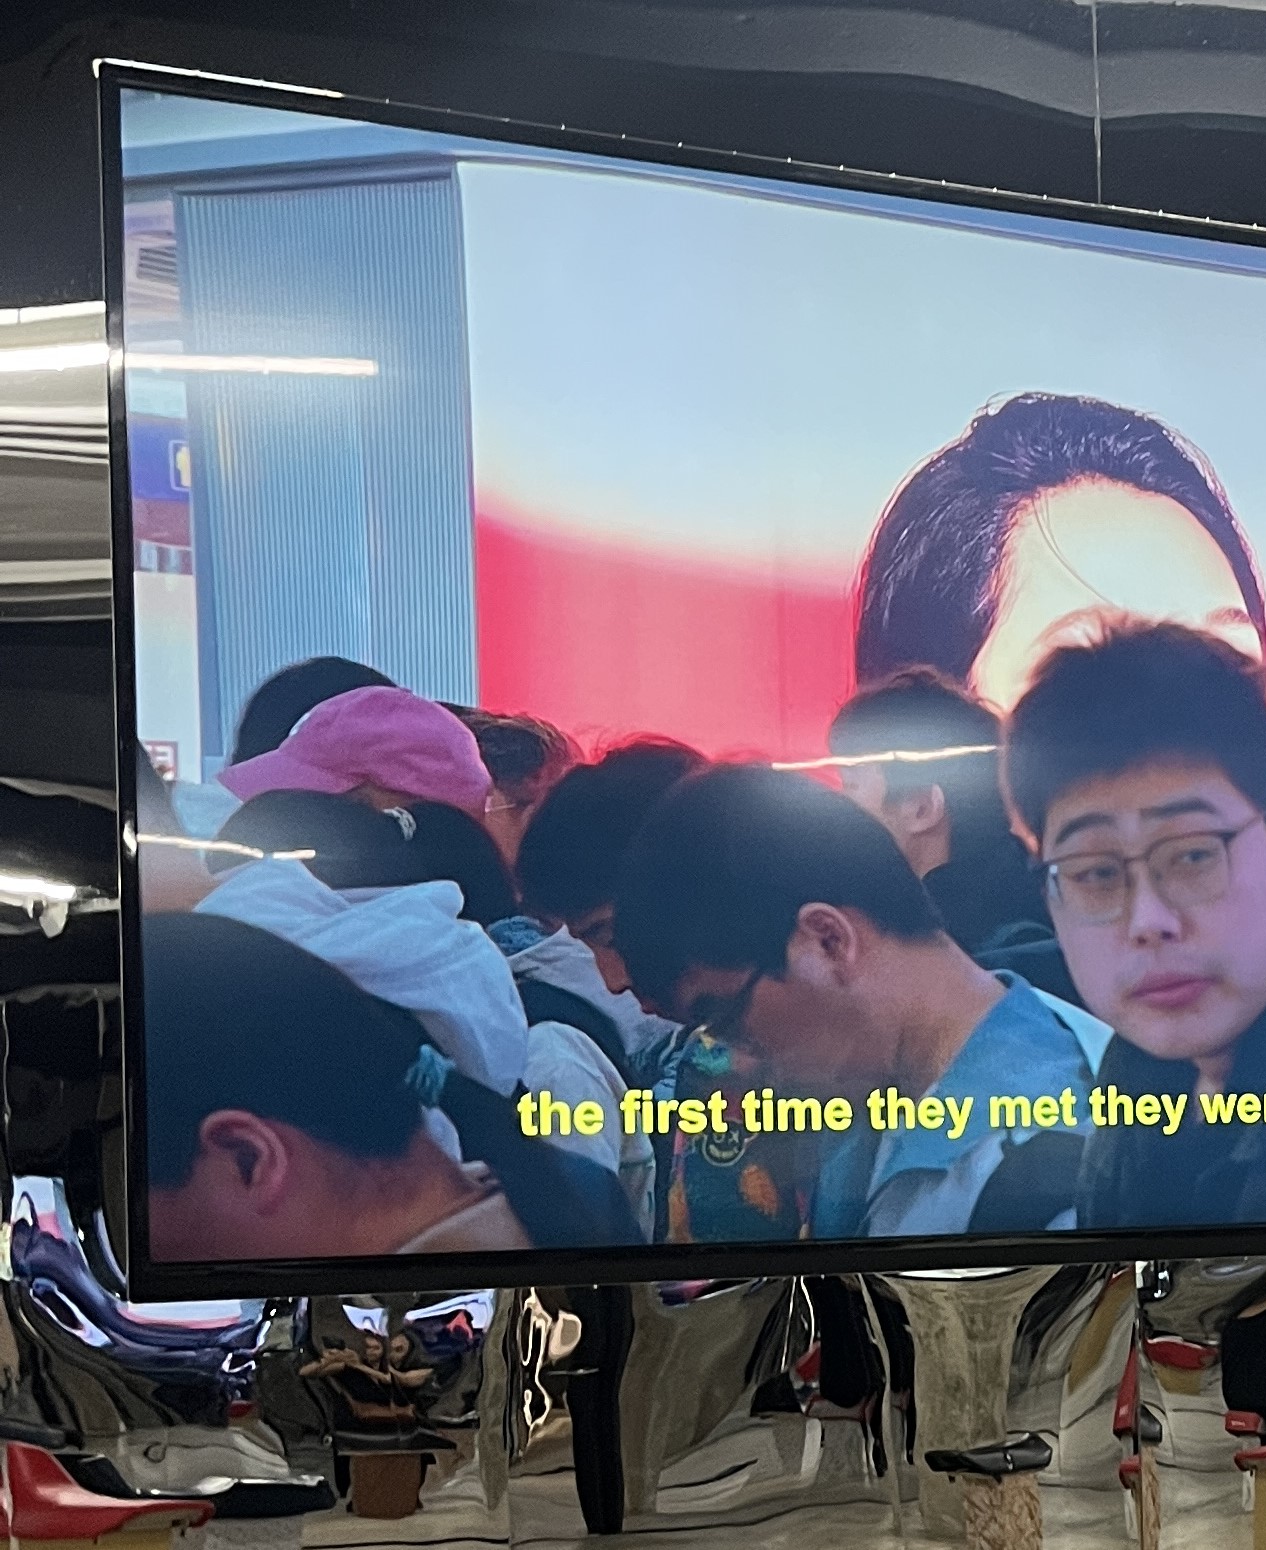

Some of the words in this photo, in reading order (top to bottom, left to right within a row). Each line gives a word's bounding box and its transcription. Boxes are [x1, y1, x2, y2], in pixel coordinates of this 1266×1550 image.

[517, 1090, 604, 1136] the
[619, 1089, 728, 1135] first
[741, 1087, 853, 1132] time
[867, 1086, 973, 1139] they
[989, 1087, 1077, 1127] met
[1089, 1085, 1188, 1135] they
